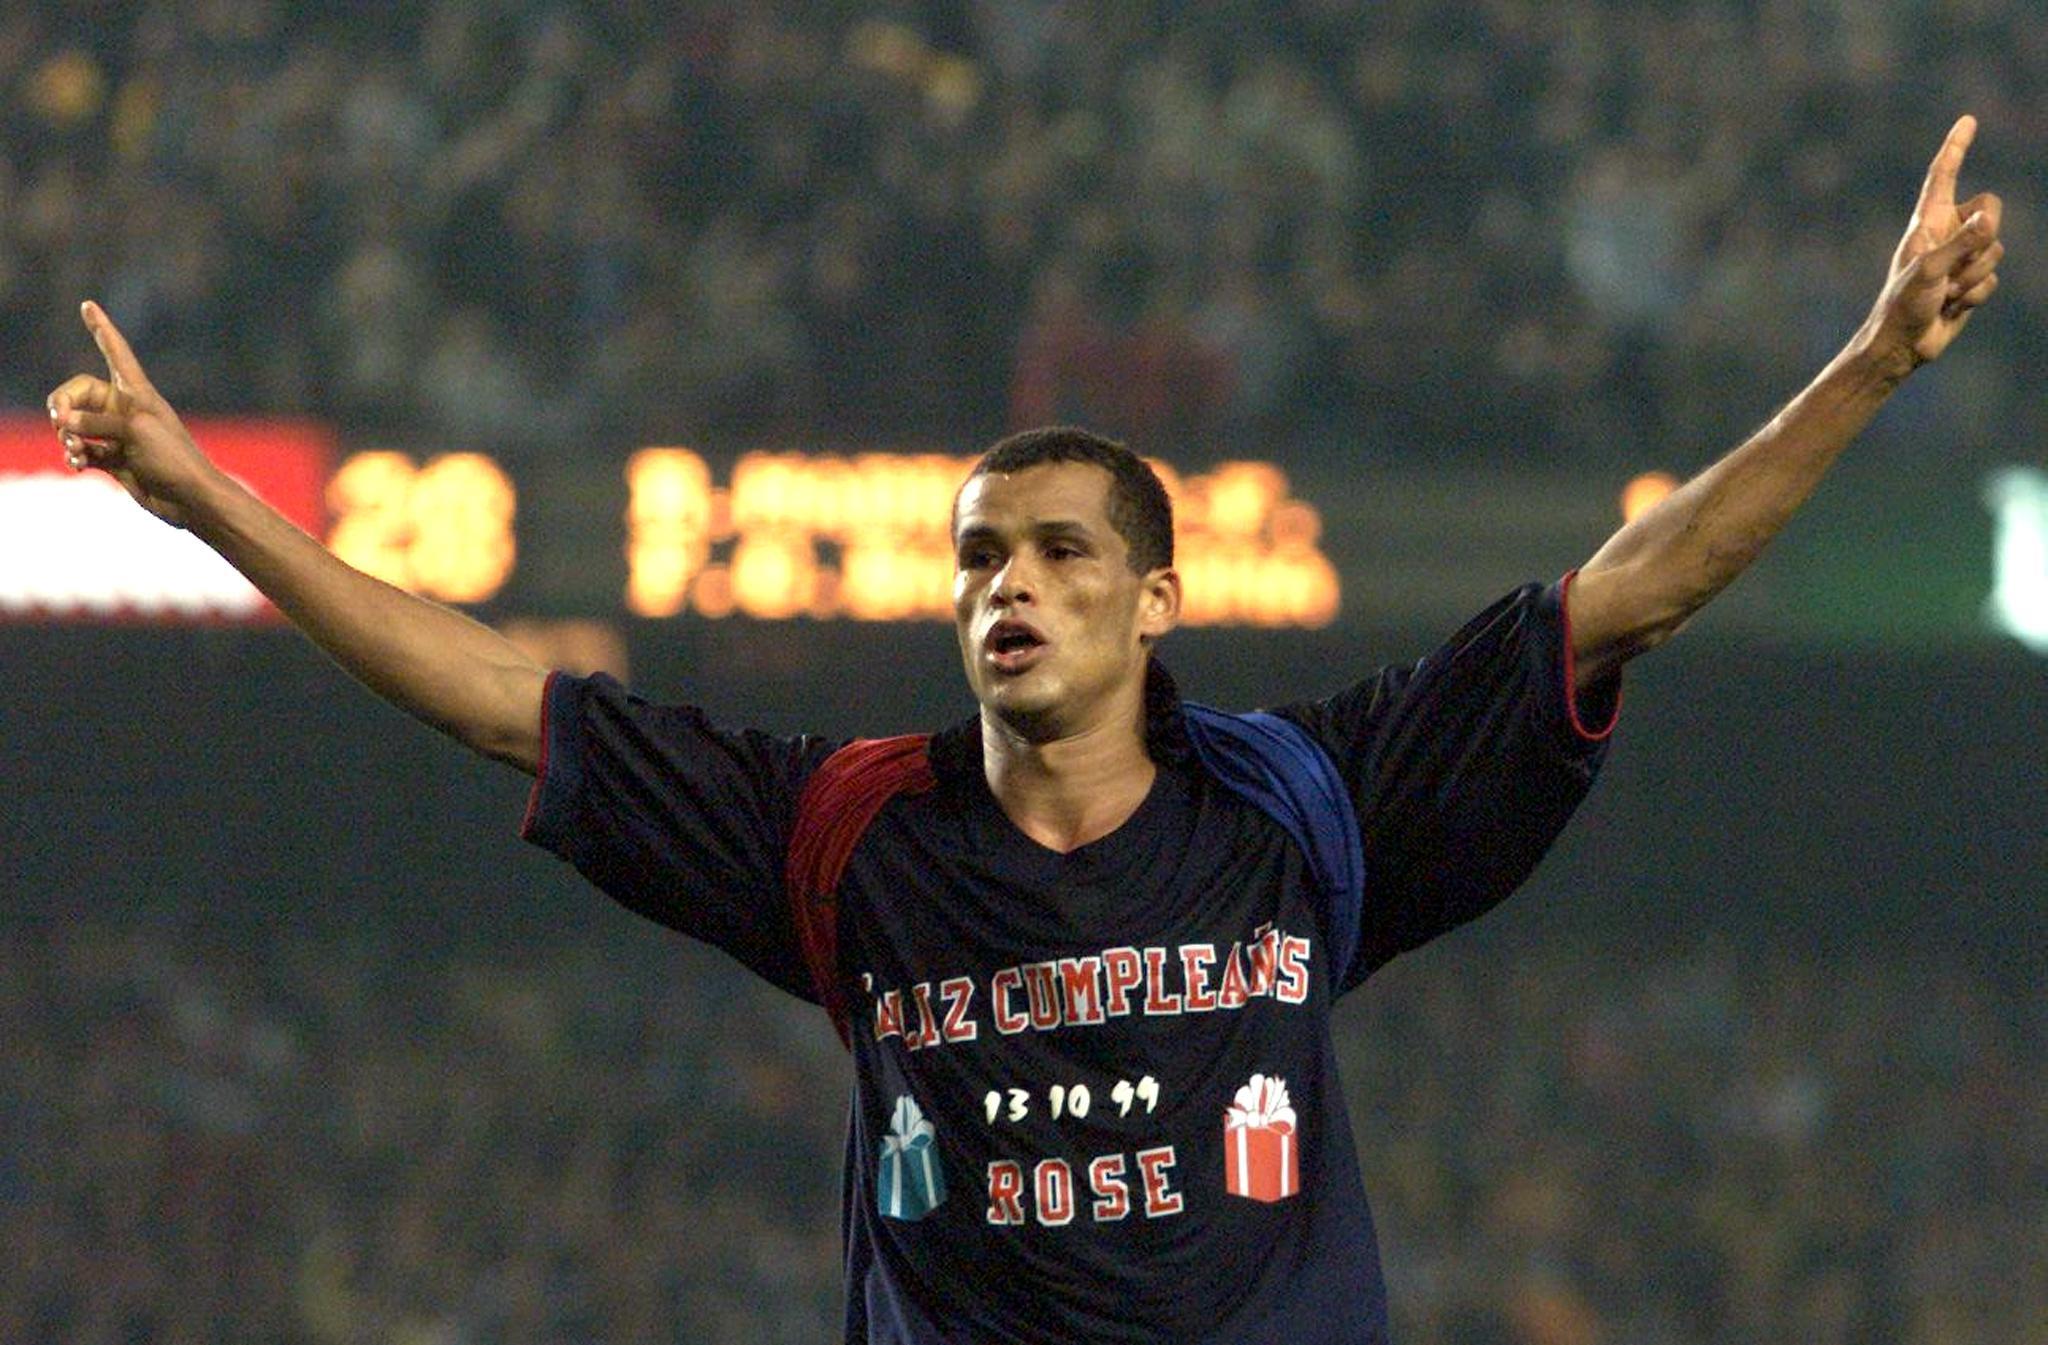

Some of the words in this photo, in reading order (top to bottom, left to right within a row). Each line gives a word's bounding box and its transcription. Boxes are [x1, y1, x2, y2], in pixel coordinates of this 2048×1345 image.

[984, 1088, 1030, 1125] 13
[1050, 1084, 1090, 1120] 10
[1111, 1075, 1160, 1118] 99
[987, 1146, 1184, 1227] ROSE
